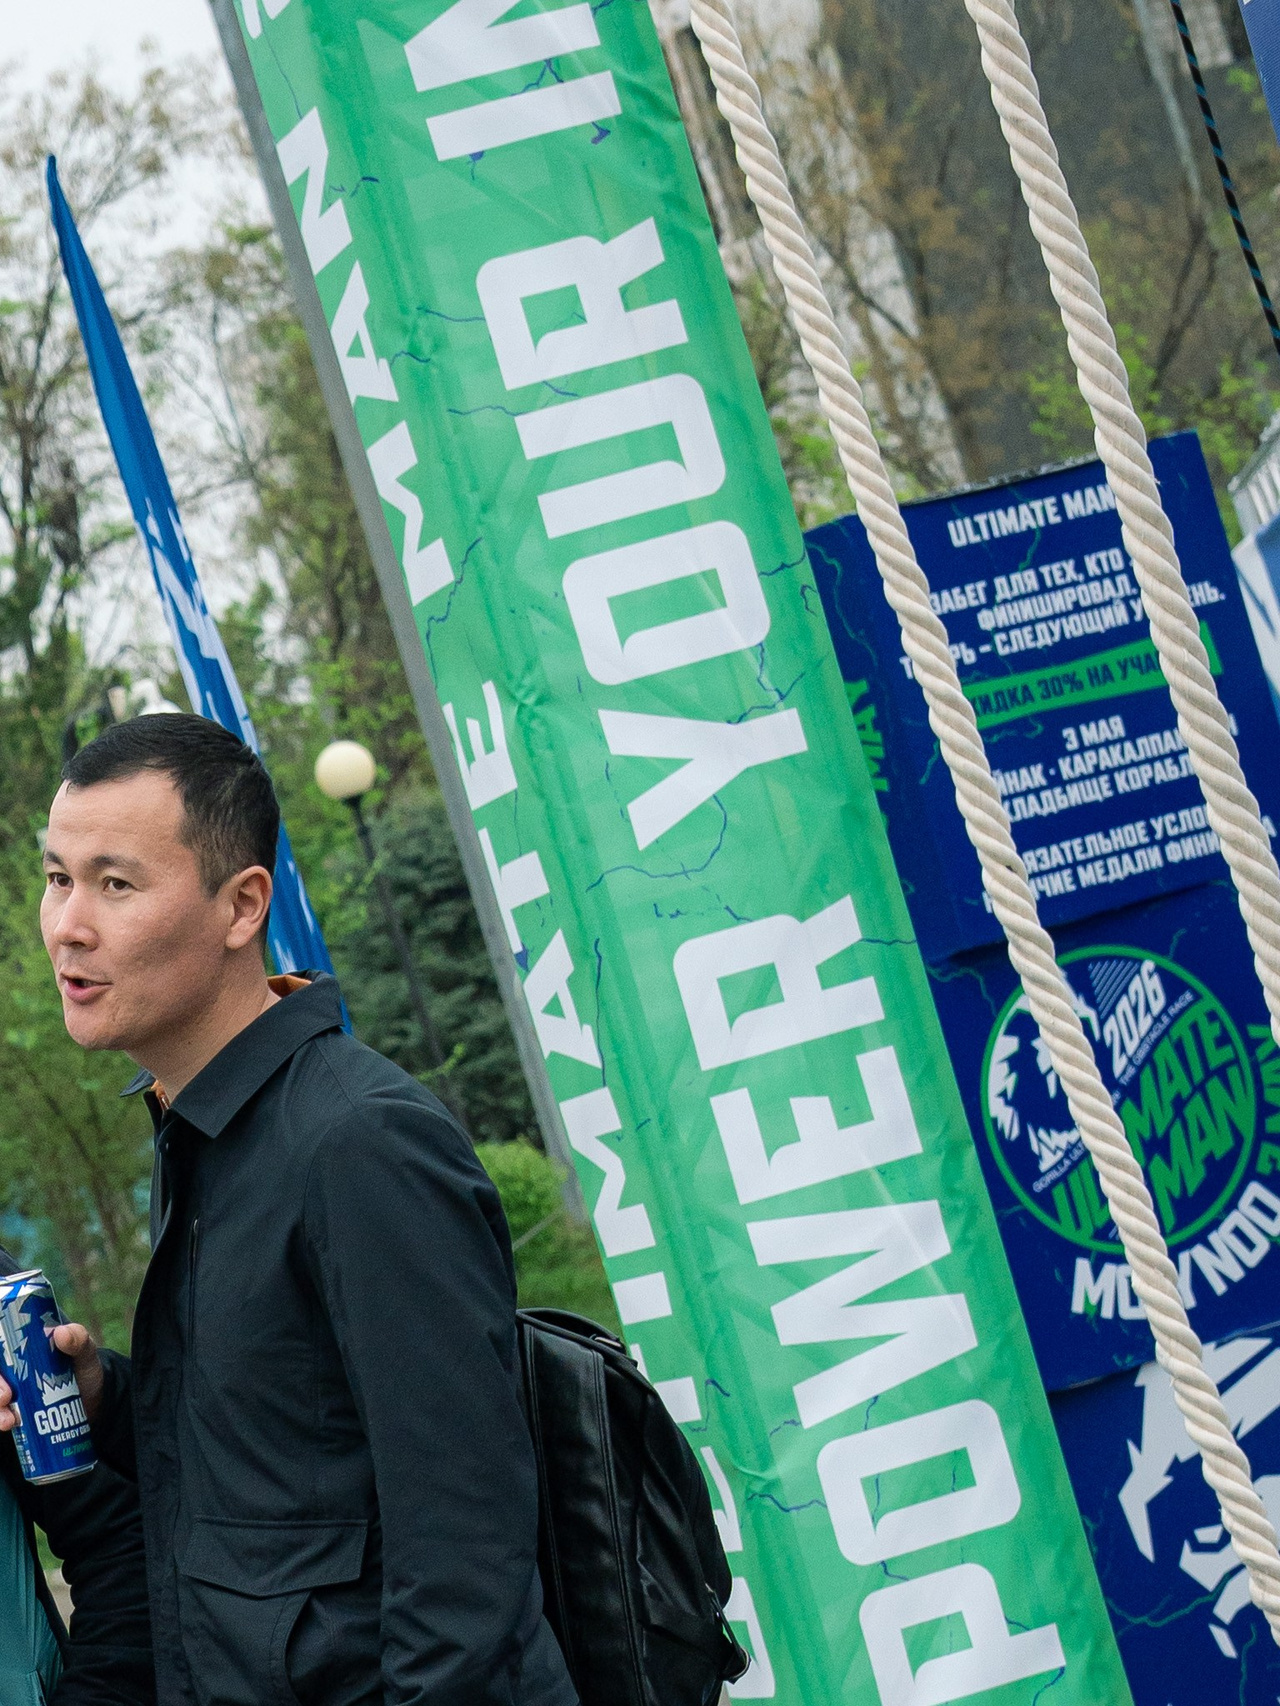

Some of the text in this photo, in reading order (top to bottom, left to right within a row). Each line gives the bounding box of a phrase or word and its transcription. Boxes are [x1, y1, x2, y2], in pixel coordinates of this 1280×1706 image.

[275, 107, 455, 606] MAN
[476, 216, 808, 851] YOUR
[947, 484, 1116, 548] ULTIMATE MAN
[928, 547, 1125, 616] ЗАБЕГ ДЛЯ ТЕХ, КТО
[977, 573, 1138, 631] ФИНИШИРОВАЛ.
[899, 642, 977, 680] ТРЬ
[994, 601, 1130, 657] СЛЕДУЮЩИЙ
[1129, 580, 1226, 622] УЕНЬ.
[973, 682, 1033, 717] ИДКА
[1037, 669, 1084, 701] 30%
[1086, 655, 1115, 690] НА
[1079, 714, 1126, 747] МАЯ
[992, 763, 1048, 796] ЙНАК
[1113, 752, 1196, 795] КОРАБЛ
[1021, 803, 1211, 874] ЯЗАТЕЛЬНОЕ УСЛО
[1076, 845, 1164, 888] МЕДАЛИ
[1103, 958, 1167, 1080] 2026
[1051, 1000, 1235, 1238] ULMATE
[1148, 1063, 1251, 1233] MAN
[51, 1429, 79, 1444] ENERGY
